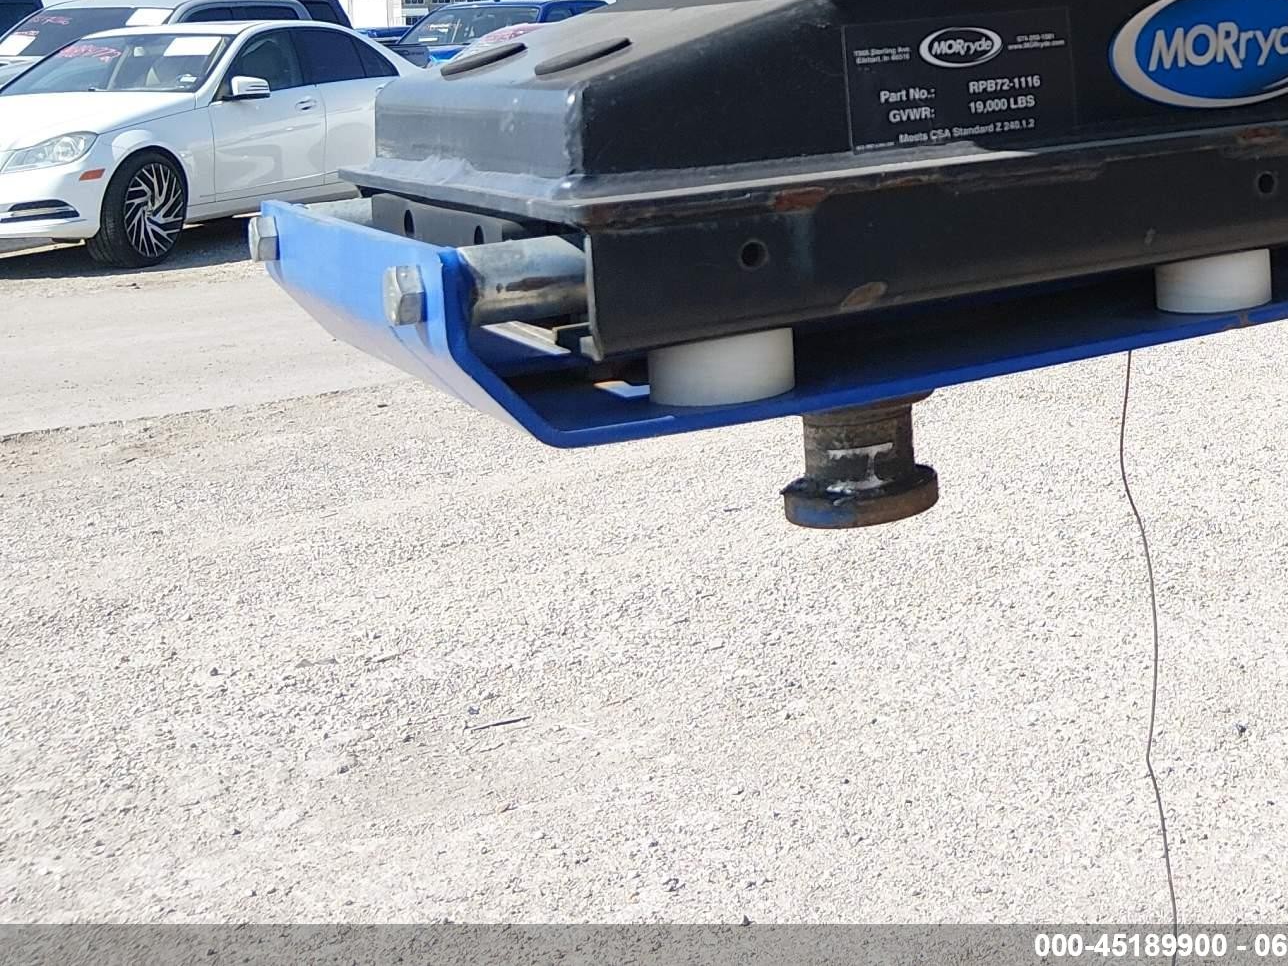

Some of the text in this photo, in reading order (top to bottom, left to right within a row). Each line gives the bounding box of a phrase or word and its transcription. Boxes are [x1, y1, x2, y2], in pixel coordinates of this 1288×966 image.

[931, 37, 993, 56] MORryde
[879, 75, 1041, 104] Part No.: RPB72-1116
[888, 94, 1036, 124] GVWR: 19,000 LBS
[929, 128, 951, 141] CSA
[952, 122, 994, 137] Standard
[995, 121, 1003, 133] Z
